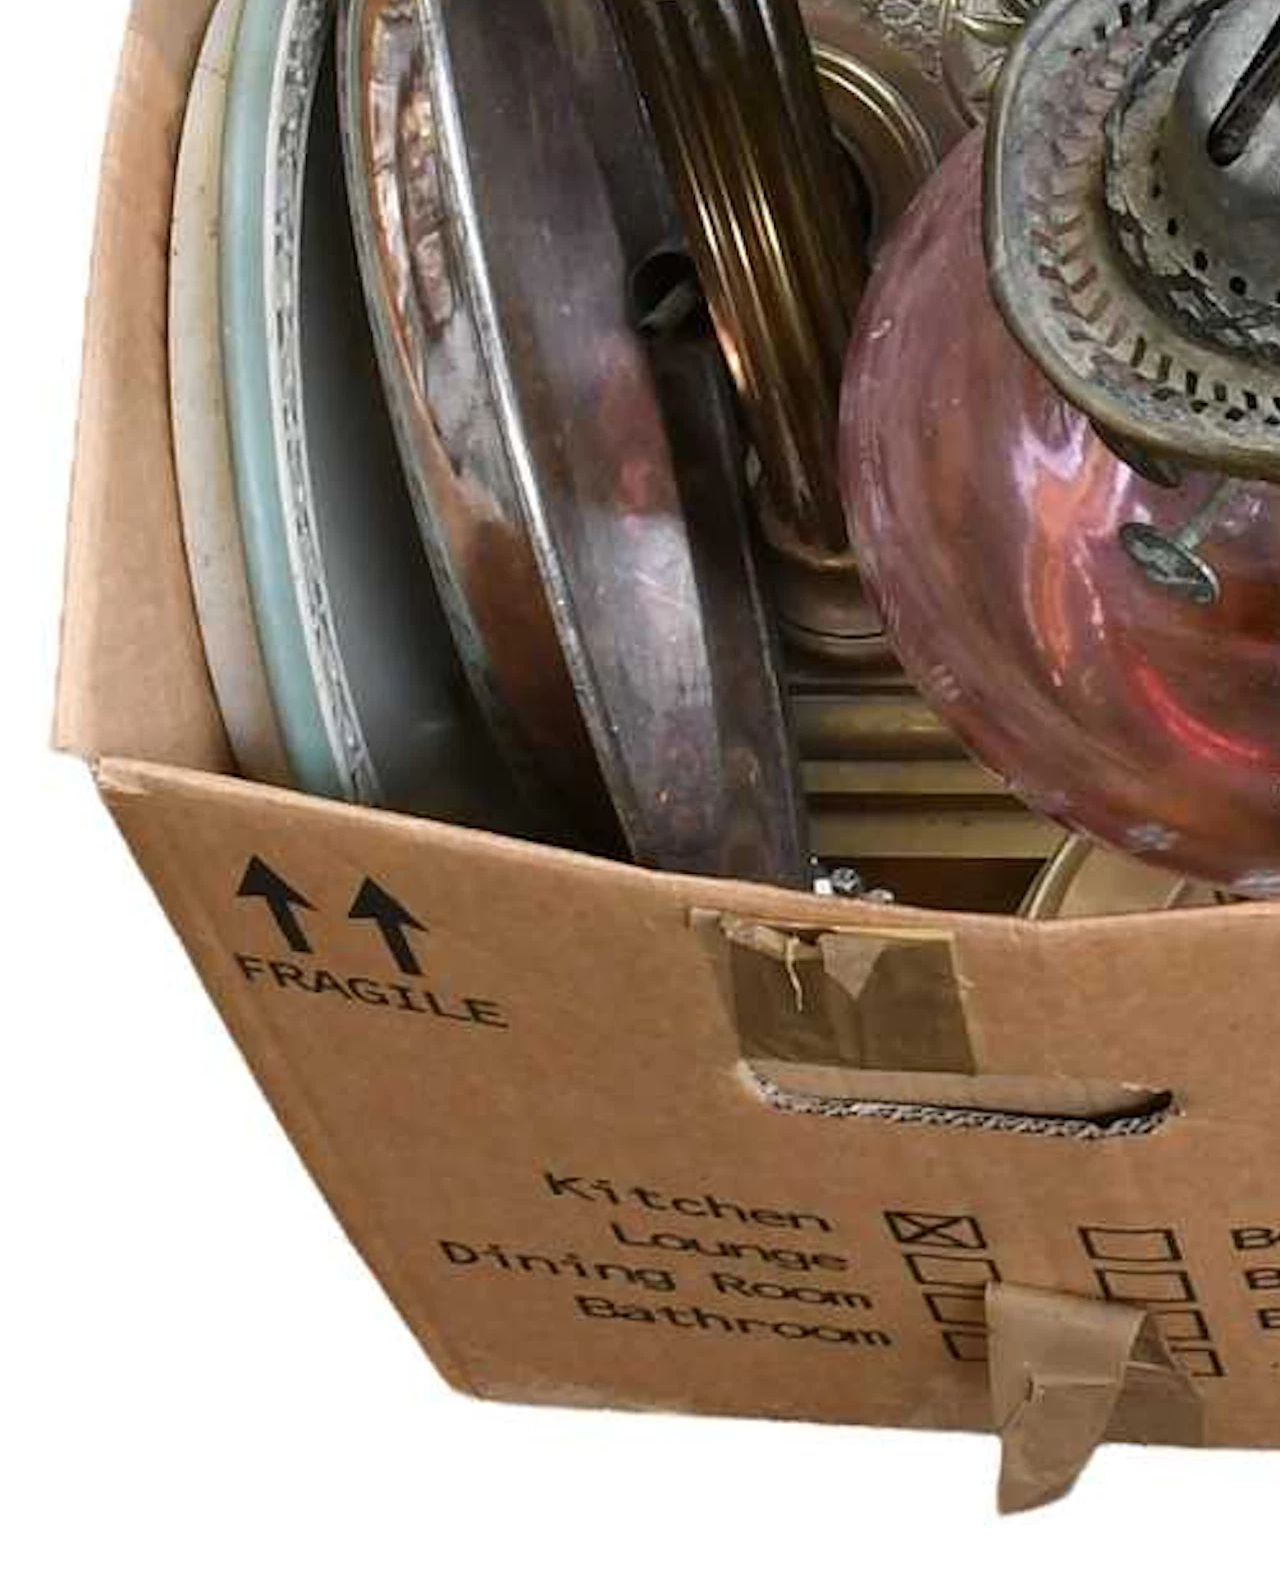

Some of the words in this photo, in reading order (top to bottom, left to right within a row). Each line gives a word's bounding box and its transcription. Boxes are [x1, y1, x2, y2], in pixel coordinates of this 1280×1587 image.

[234, 952, 509, 1029] FRAGILE
[543, 1170, 833, 1233] Kitchen
[438, 1238, 677, 1294] Dining
[713, 1270, 874, 1311] Room
[610, 1220, 849, 1273] Lounge
[574, 1293, 896, 1348] Bathroom
